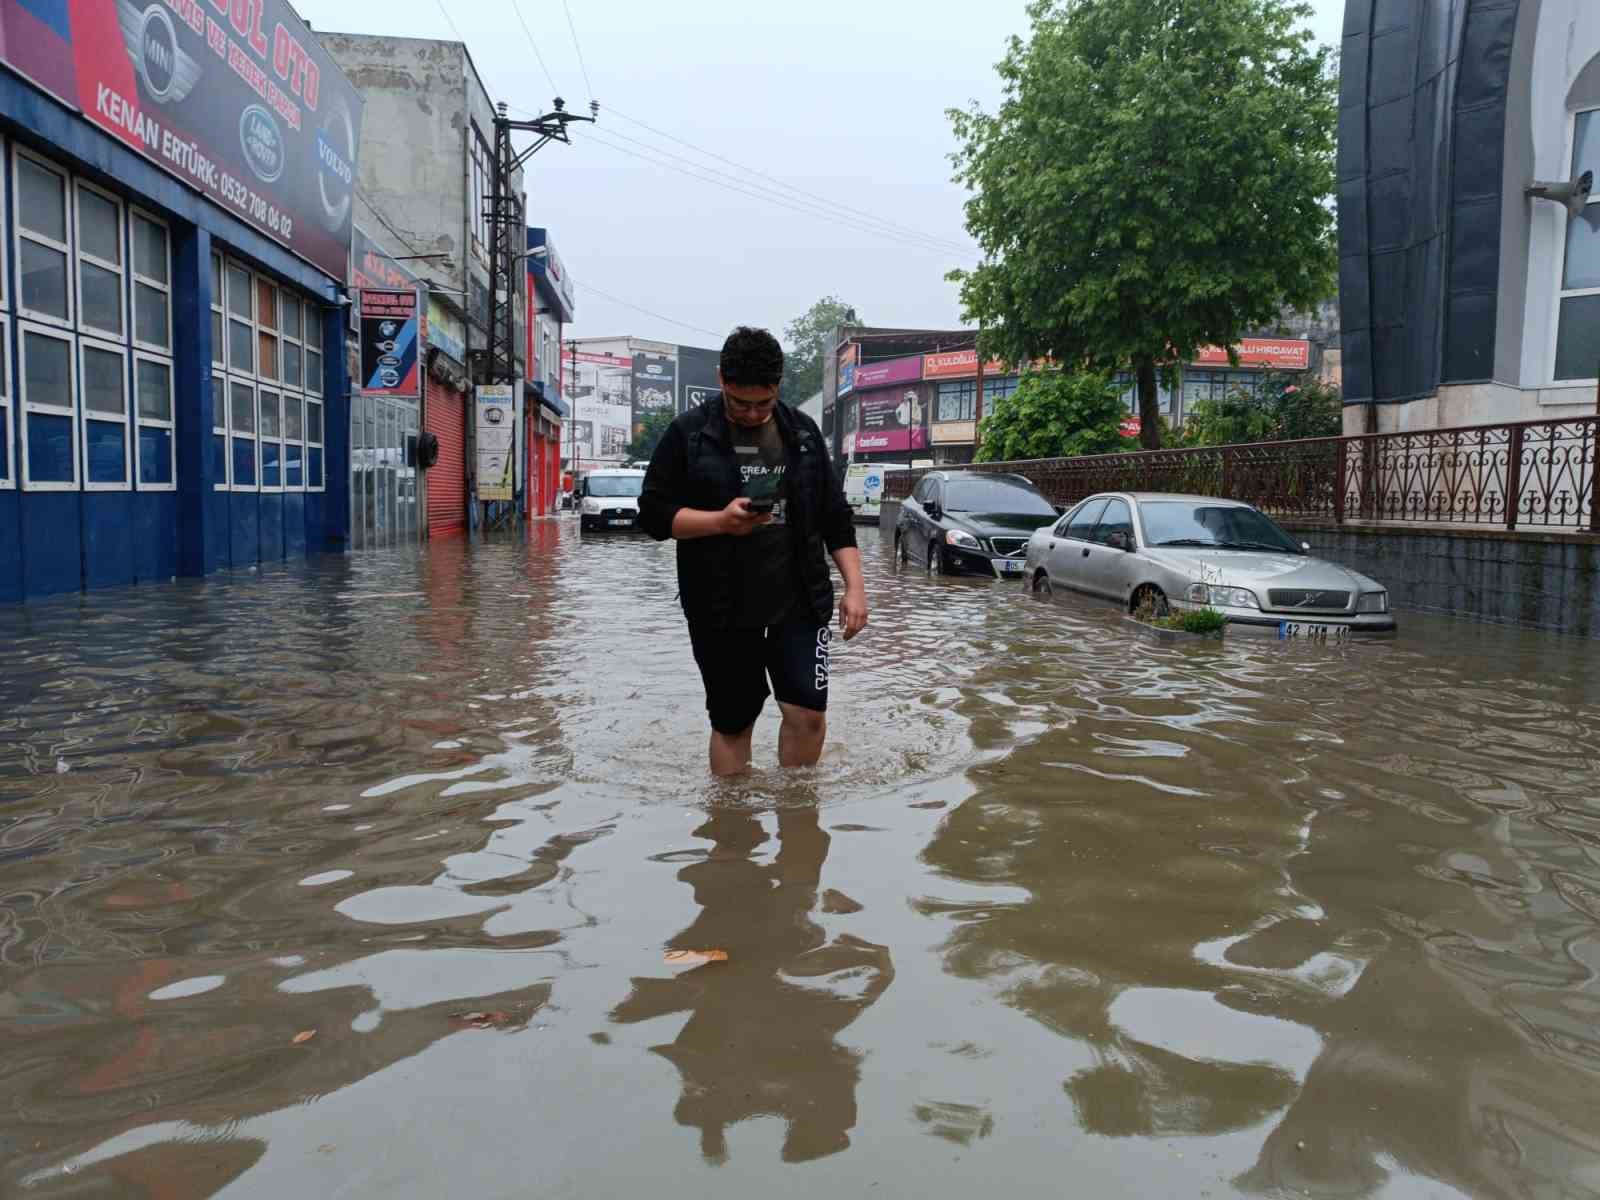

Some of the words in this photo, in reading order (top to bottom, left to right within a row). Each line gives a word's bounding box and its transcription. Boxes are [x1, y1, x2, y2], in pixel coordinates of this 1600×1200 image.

[207, 0, 268, 59] UL
[273, 21, 320, 112] OTO
[96, 81, 159, 150] KENAN
[161, 128, 218, 190] ERTÜRK:
[220, 177, 248, 211] 0532
[248, 192, 267, 225] 708
[267, 209, 280, 231] 06
[279, 214, 293, 240] 02
[317, 137, 352, 184] VOLVO
